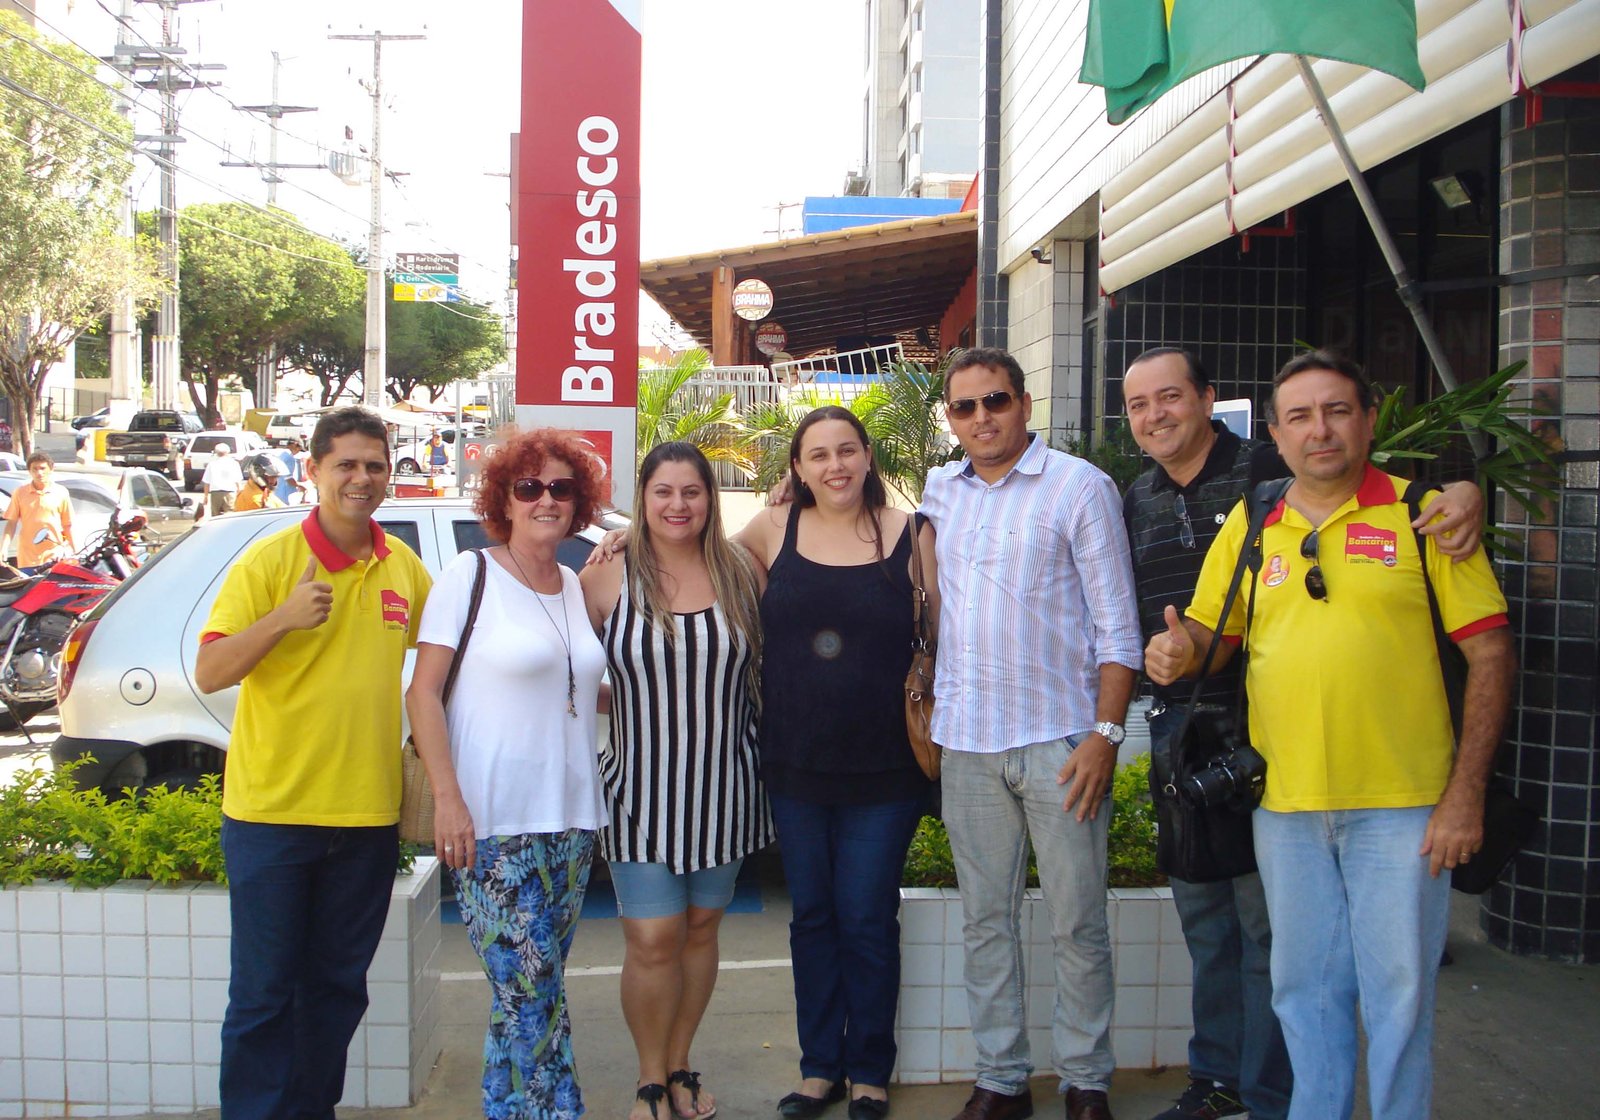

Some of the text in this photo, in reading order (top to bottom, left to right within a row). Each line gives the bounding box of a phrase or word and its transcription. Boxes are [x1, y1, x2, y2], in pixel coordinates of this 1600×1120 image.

[561, 115, 619, 402] Bradesco
[735, 293, 771, 306] BRAHMA
[757, 334, 785, 344] BRAHMA
